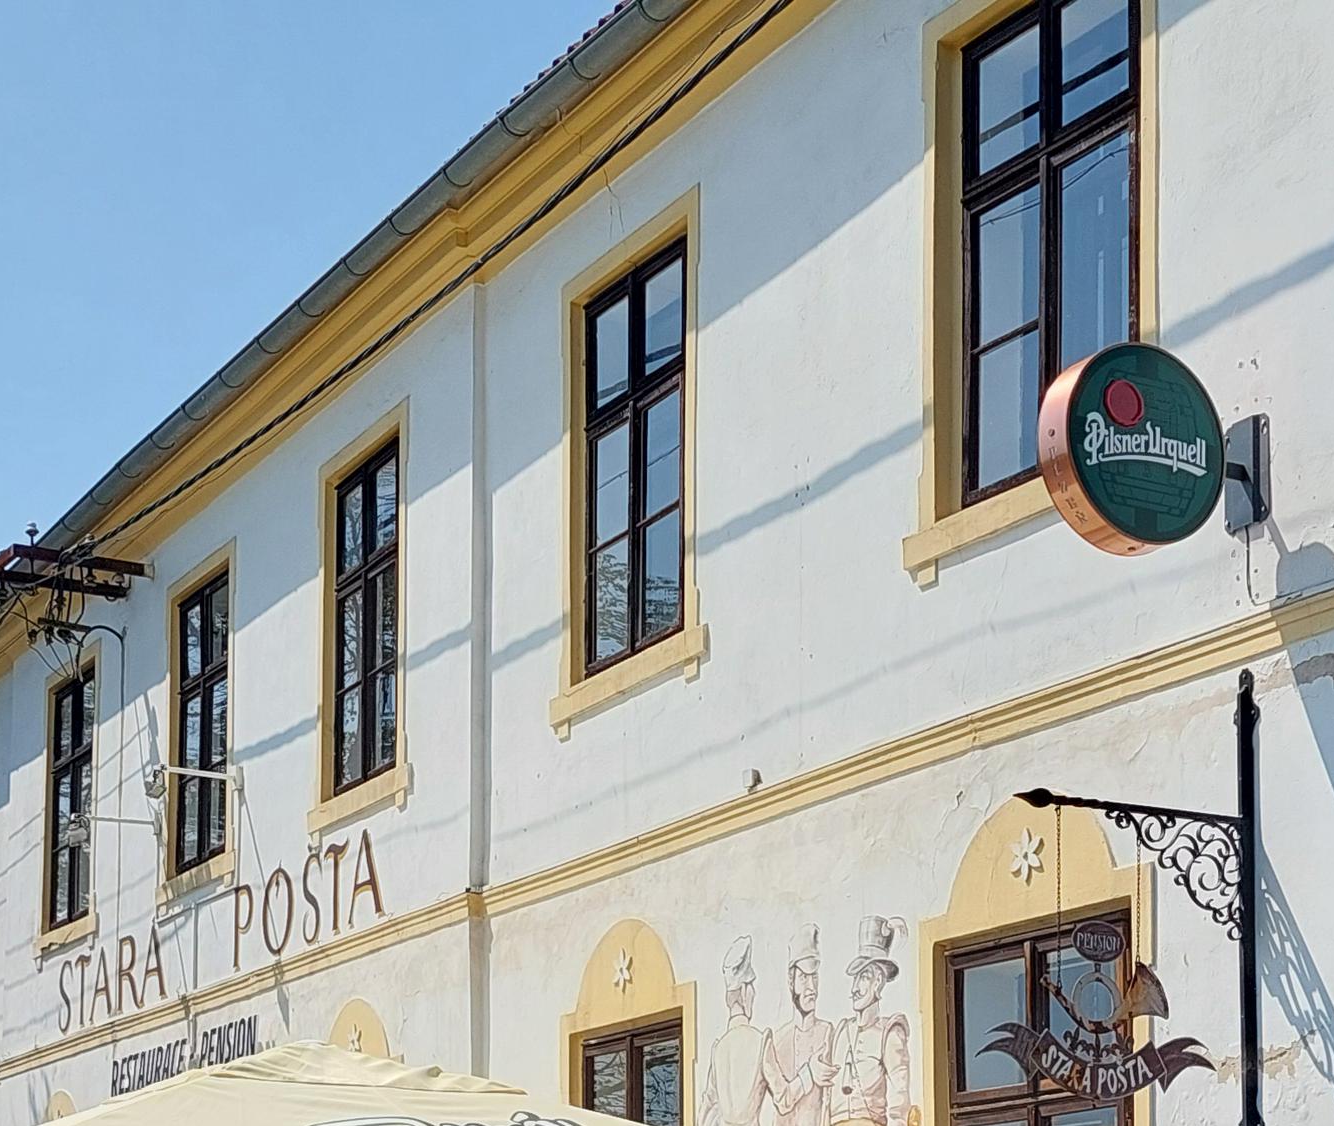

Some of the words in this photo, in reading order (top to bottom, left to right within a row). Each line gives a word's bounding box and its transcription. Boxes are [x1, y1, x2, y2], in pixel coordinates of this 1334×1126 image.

[1083, 411, 1148, 466] Pilsner
[1146, 421, 1207, 473] Urquell
[1076, 932, 1121, 951] PENSION
[111, 1039, 188, 1098] RESTAURACE
[199, 1015, 258, 1070] PENSION
